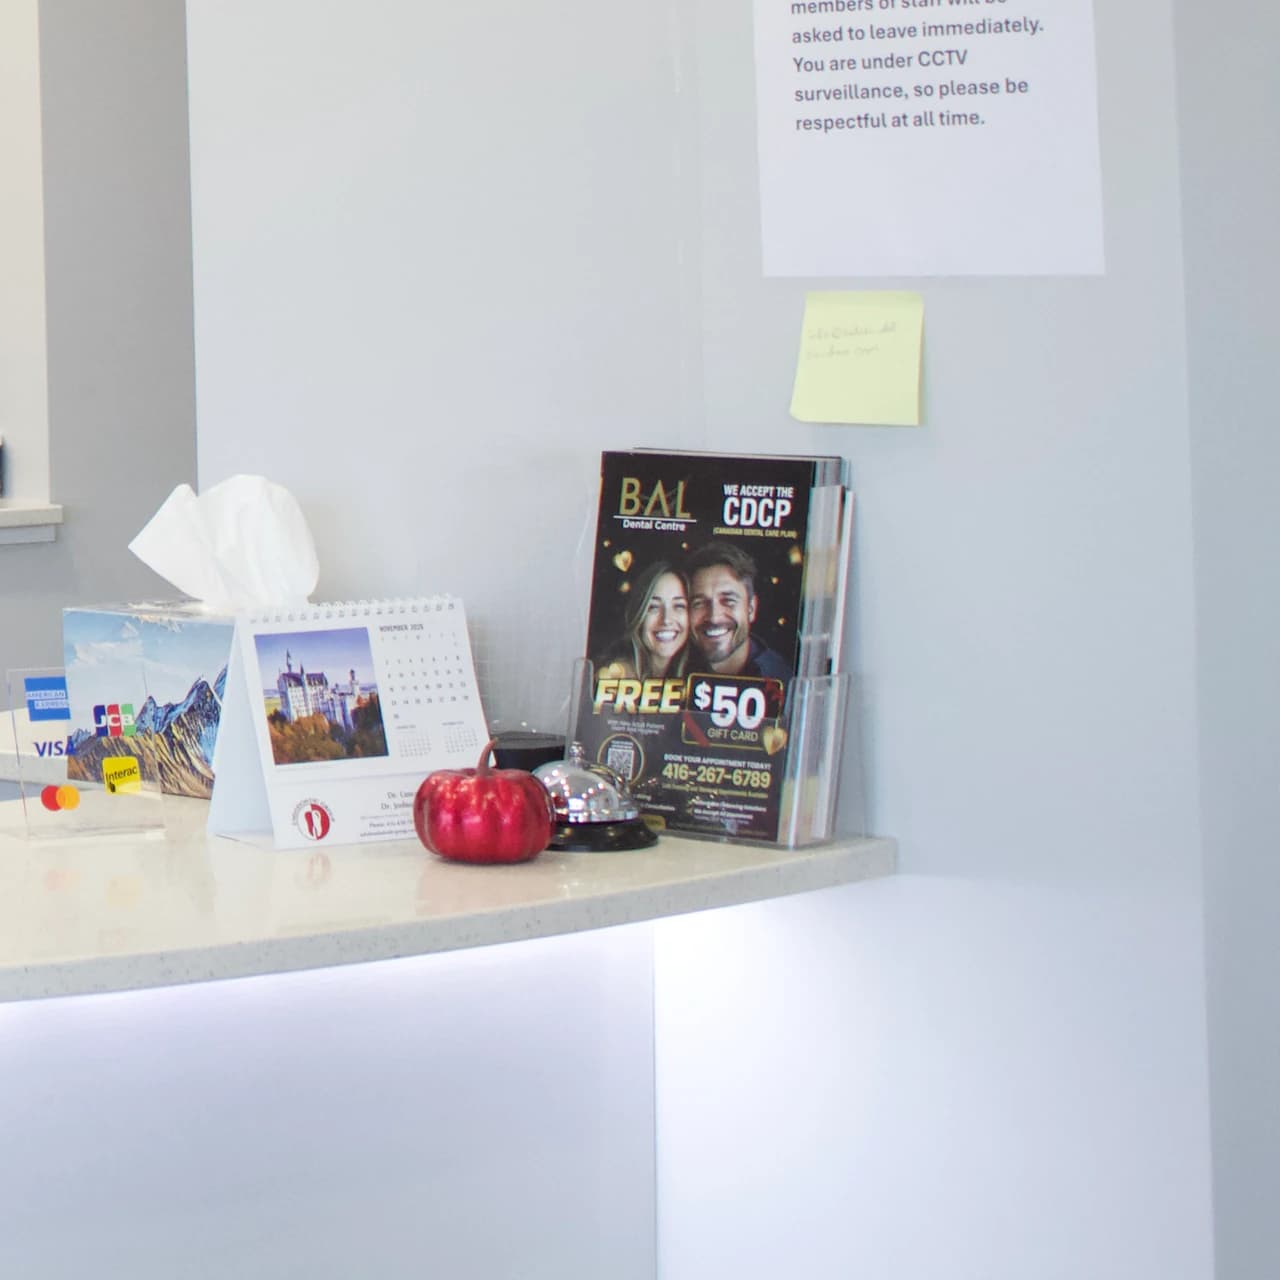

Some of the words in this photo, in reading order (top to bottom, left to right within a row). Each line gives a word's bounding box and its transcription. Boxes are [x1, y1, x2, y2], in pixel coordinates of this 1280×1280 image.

[792, 25, 843, 44] asked
[847, 26, 866, 41] to
[870, 23, 918, 40] leave
[922, 16, 1045, 38] immediately.
[793, 56, 825, 73] You
[829, 57, 857, 72] are
[861, 52, 914, 70] under
[917, 49, 968, 67] CCTV
[794, 83, 910, 102] surveillance,
[913, 83, 935, 98] so
[939, 79, 1001, 100] please
[1005, 77, 1029, 94] be
[795, 113, 888, 134] respectful
[891, 113, 909, 128] at
[912, 110, 935, 127] all
[939, 109, 986, 127] time.
[619, 477, 691, 519] BAL
[723, 484, 739, 496] WE
[739, 484, 774, 497] ACCEPT
[775, 486, 794, 498] THE
[723, 497, 791, 528] CDCP
[623, 519, 653, 530] Dental
[654, 521, 686, 532] Centre
[593, 678, 684, 714] FREE
[694, 681, 767, 730] $50
[95, 714, 136, 728] JCB
[707, 727, 729, 739] GIFT
[730, 730, 759, 742] CARD
[34, 740, 77, 757] VISA
[105, 766, 138, 782] Interac
[662, 763, 772, 789] 416-267-6789
